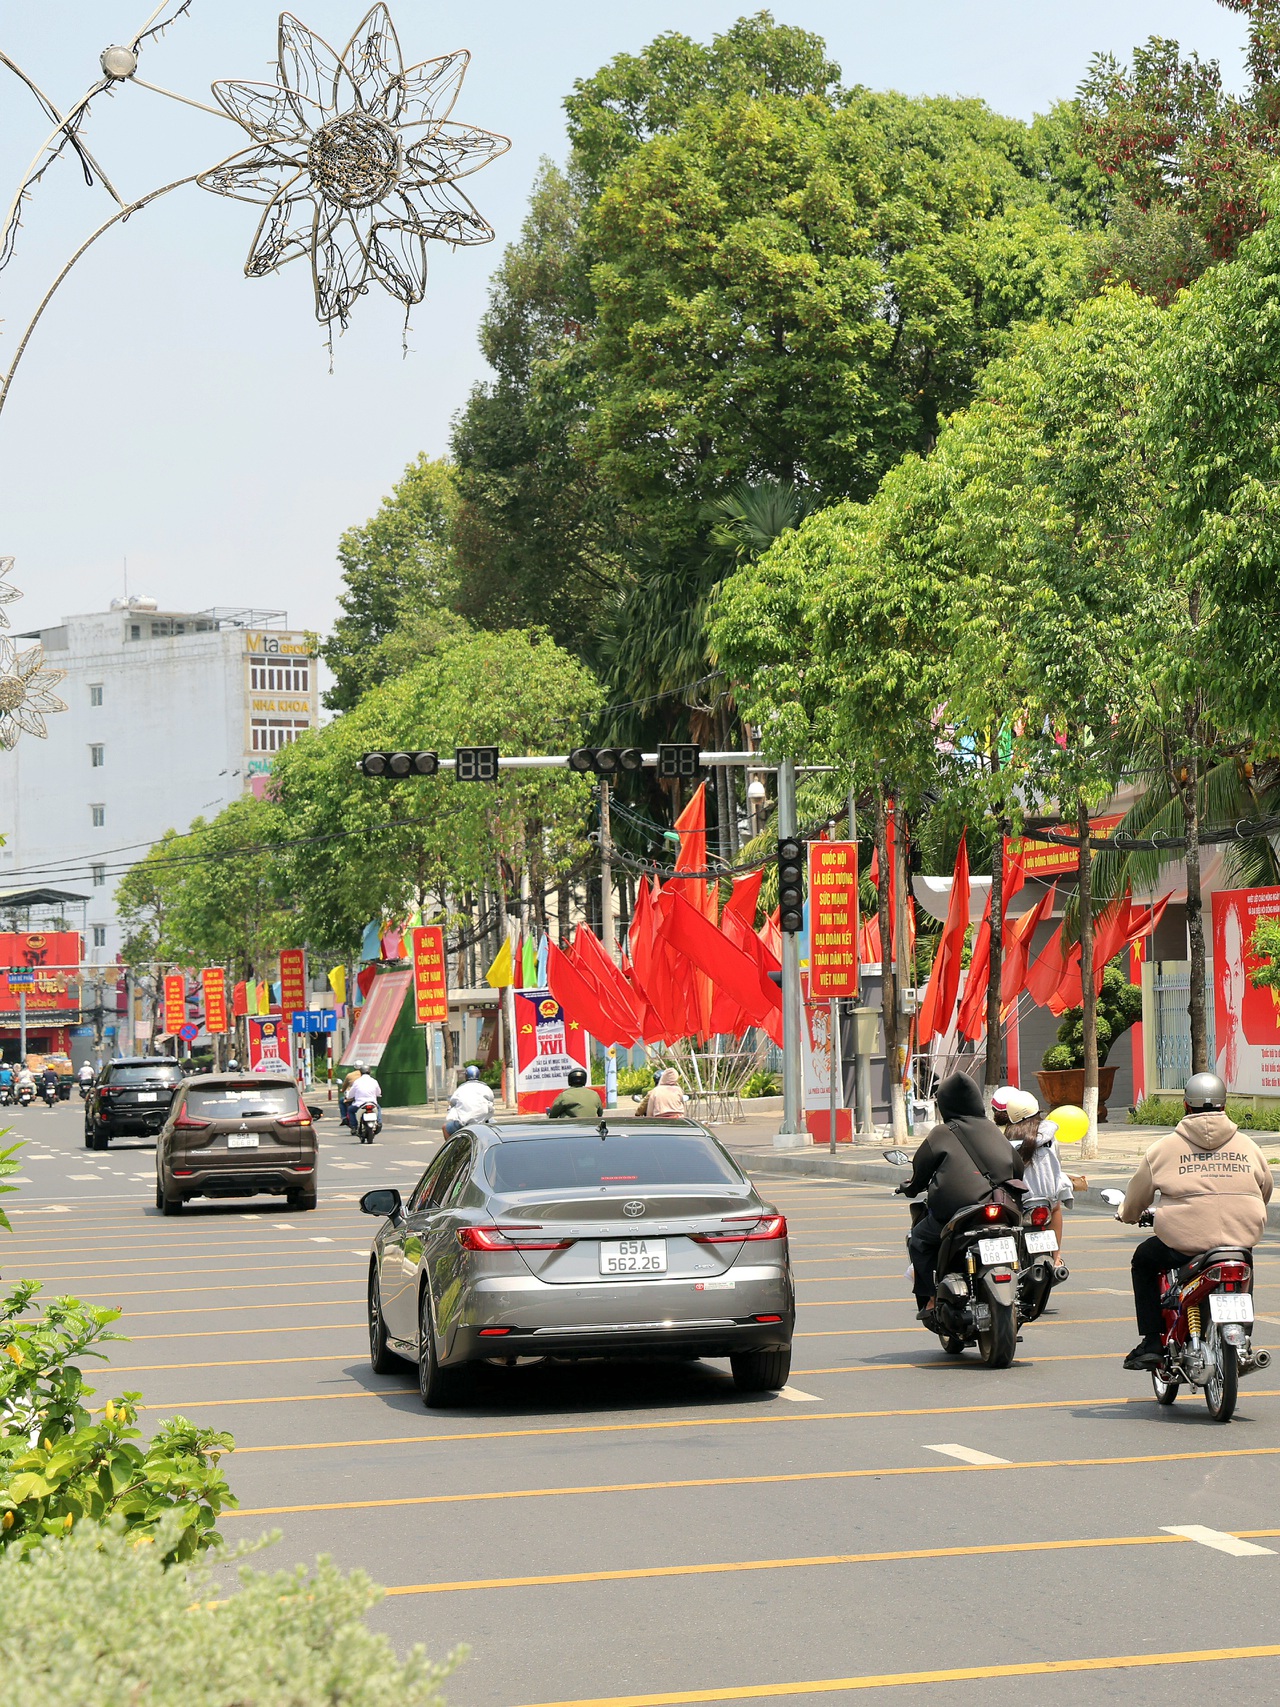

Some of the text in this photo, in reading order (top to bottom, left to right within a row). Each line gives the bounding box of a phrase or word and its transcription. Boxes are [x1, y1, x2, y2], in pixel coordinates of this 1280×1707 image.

[253, 699, 309, 713] NHA KHOA
[822, 849, 846, 867] QUỐC HỘI
[814, 869, 853, 887] LÀ BIỂU TƯỢNG
[819, 891, 848, 907] SỨC MẠNH
[820, 913, 832, 925] TINH
[421, 934, 434, 948] ĐẢNG
[815, 929, 852, 947] ĐẠI ĐOÀN KẾT
[418, 950, 440, 967] CỘNG SẢN
[814, 950, 853, 967] TOÀN DÂN TỘC
[419, 970, 429, 984] VIỆT
[430, 971, 441, 982] NAM
[820, 971, 832, 987] VIỆT
[833, 973, 848, 985] NAM!
[418, 987, 444, 1001] QUANG VINH
[419, 1004, 432, 1016] MUÔN
[540, 1040, 563, 1055] XVI
[1180, 1152, 1248, 1163] INTERBREAK
[1179, 1163, 1251, 1175] DEPARTMENT
[619, 1242, 648, 1255] 65A
[985, 1240, 1009, 1251] 65-AB
[608, 1256, 660, 1271] 562.26
